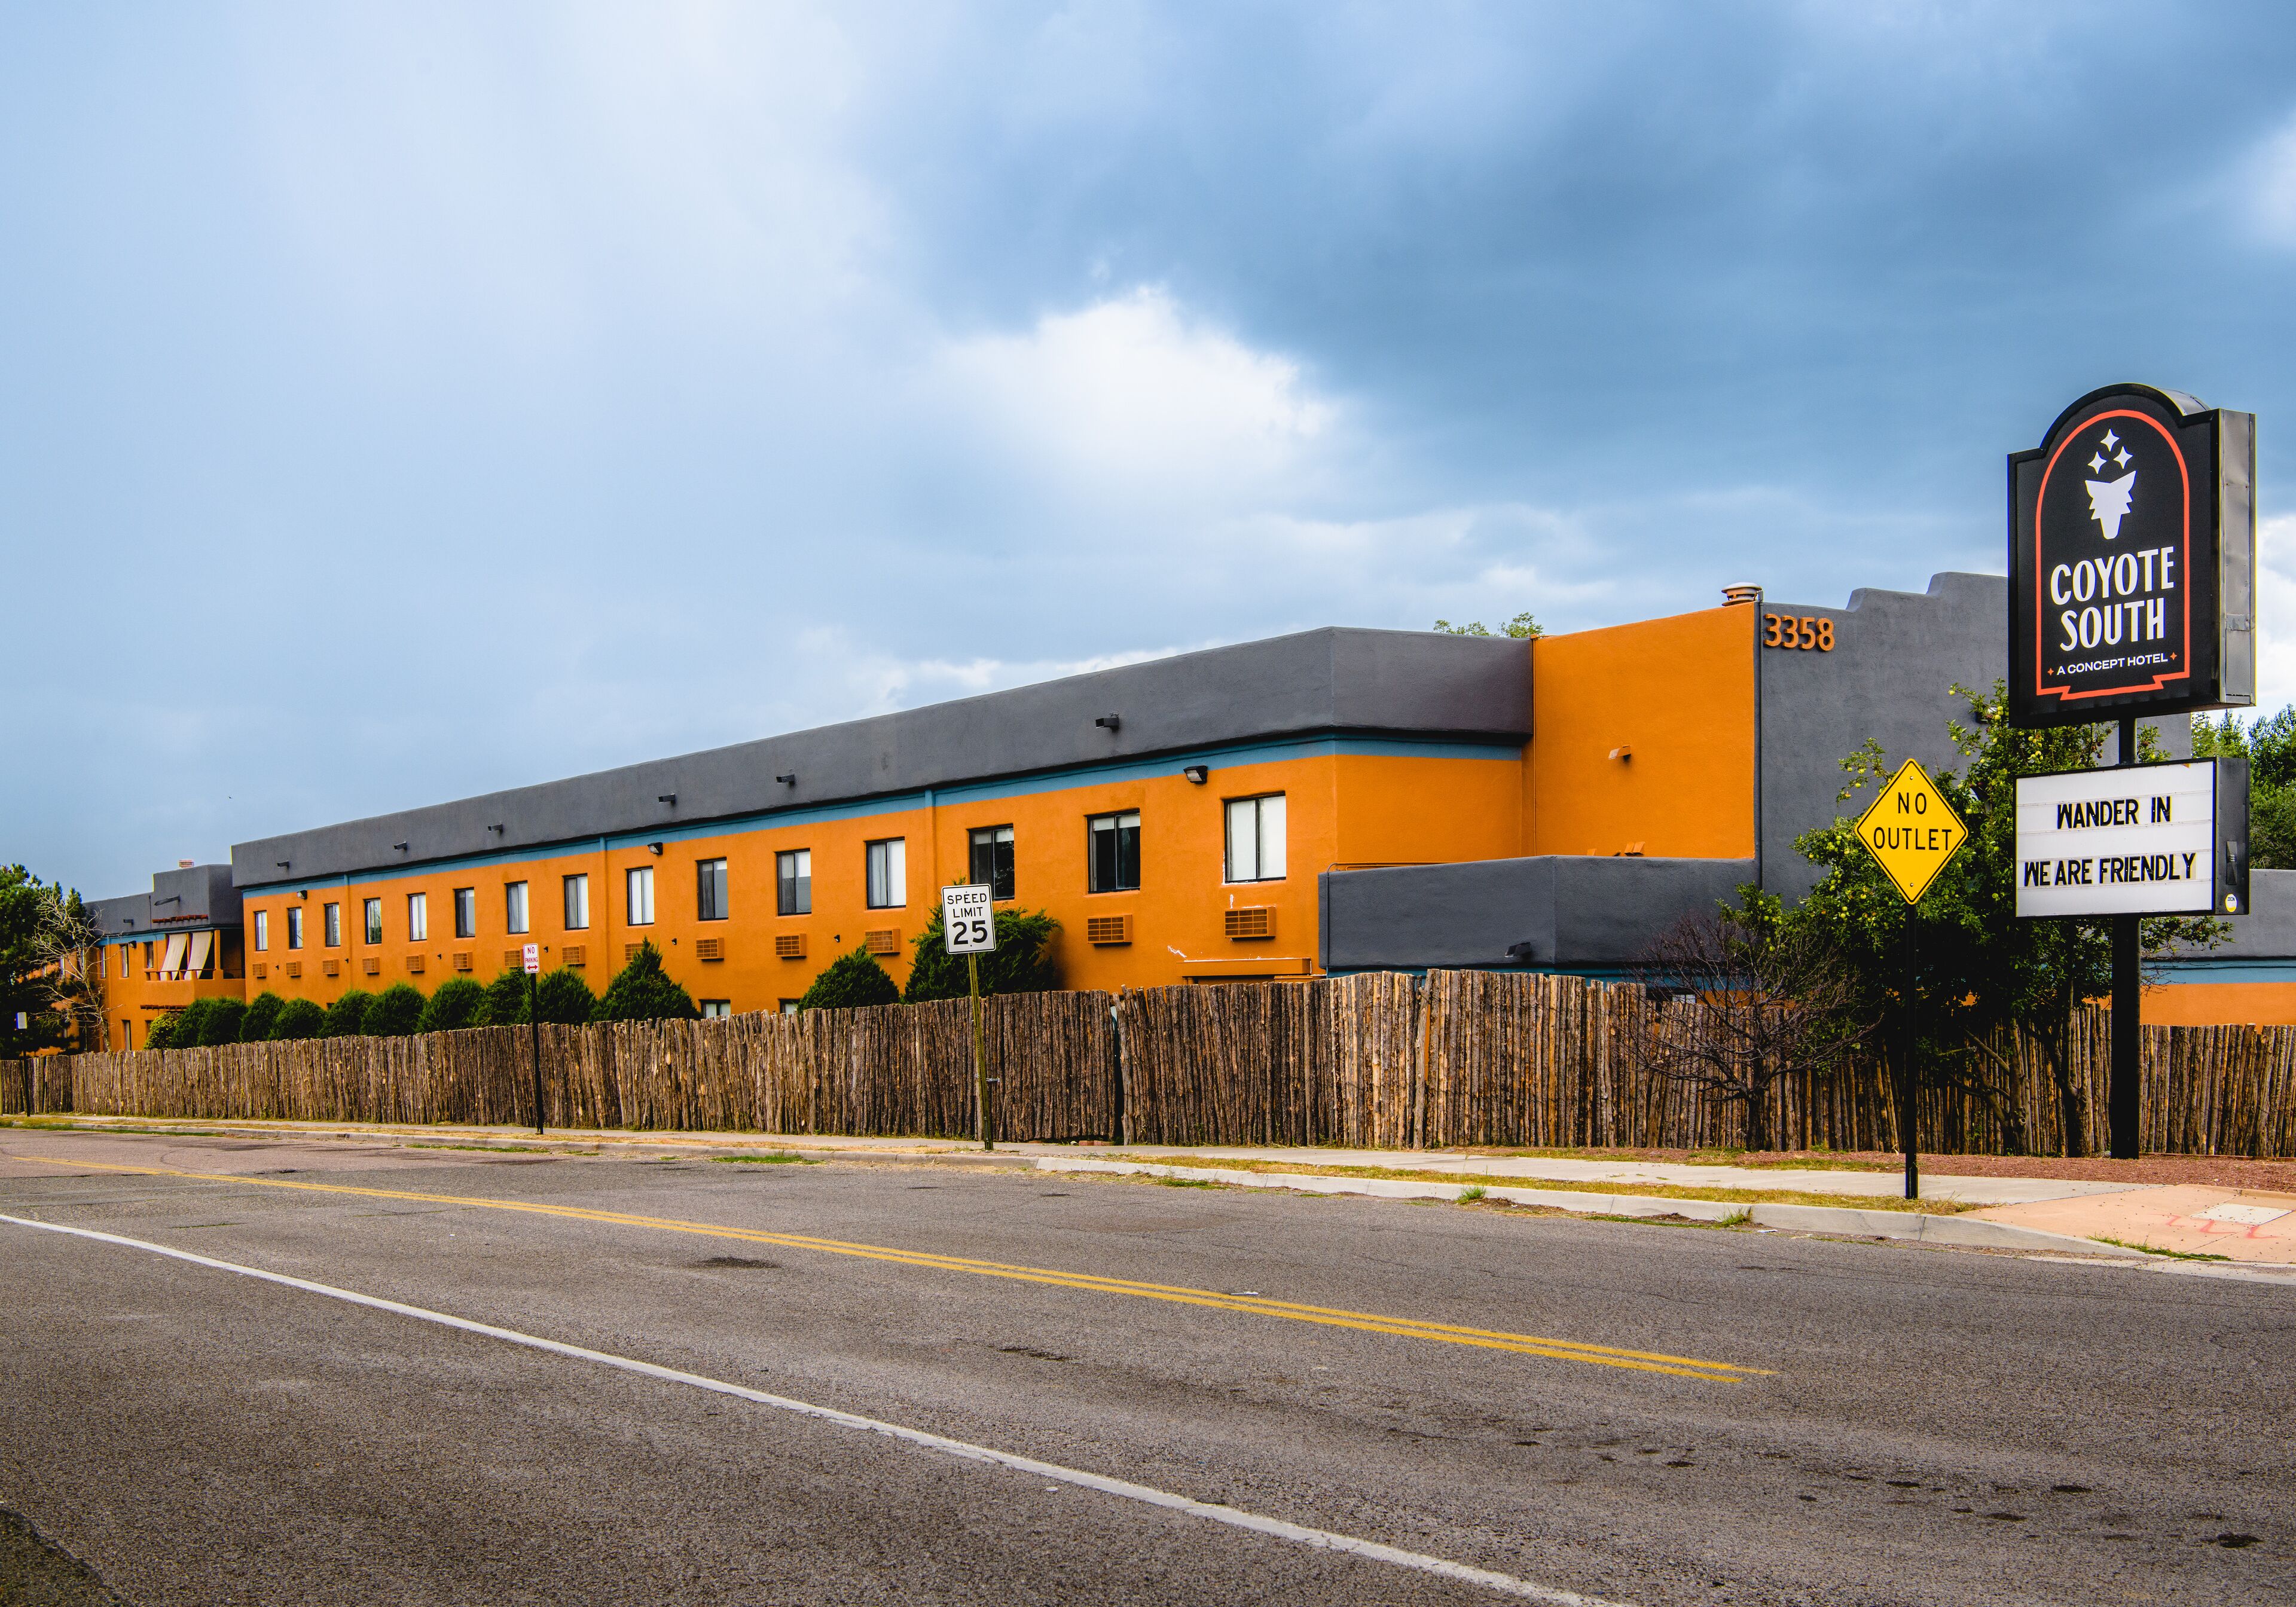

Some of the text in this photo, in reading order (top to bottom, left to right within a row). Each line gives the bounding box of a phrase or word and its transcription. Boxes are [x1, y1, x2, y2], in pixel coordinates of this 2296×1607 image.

[2050, 546, 2175, 605] COYOTE
[1764, 613, 1834, 651] 3358
[2060, 598, 2164, 652] SOUTH
[2057, 653, 2168, 675] A CONCEPT HOTEL
[1898, 792, 1927, 814] NO
[2057, 796, 2171, 829] WANDER IN
[1874, 829, 1952, 850] OUTLET
[2024, 853, 2196, 887] WE ARE FRIENDLY
[947, 893, 987, 905] SPEED
[953, 907, 983, 918] LIMIT
[952, 920, 988, 945] 25
